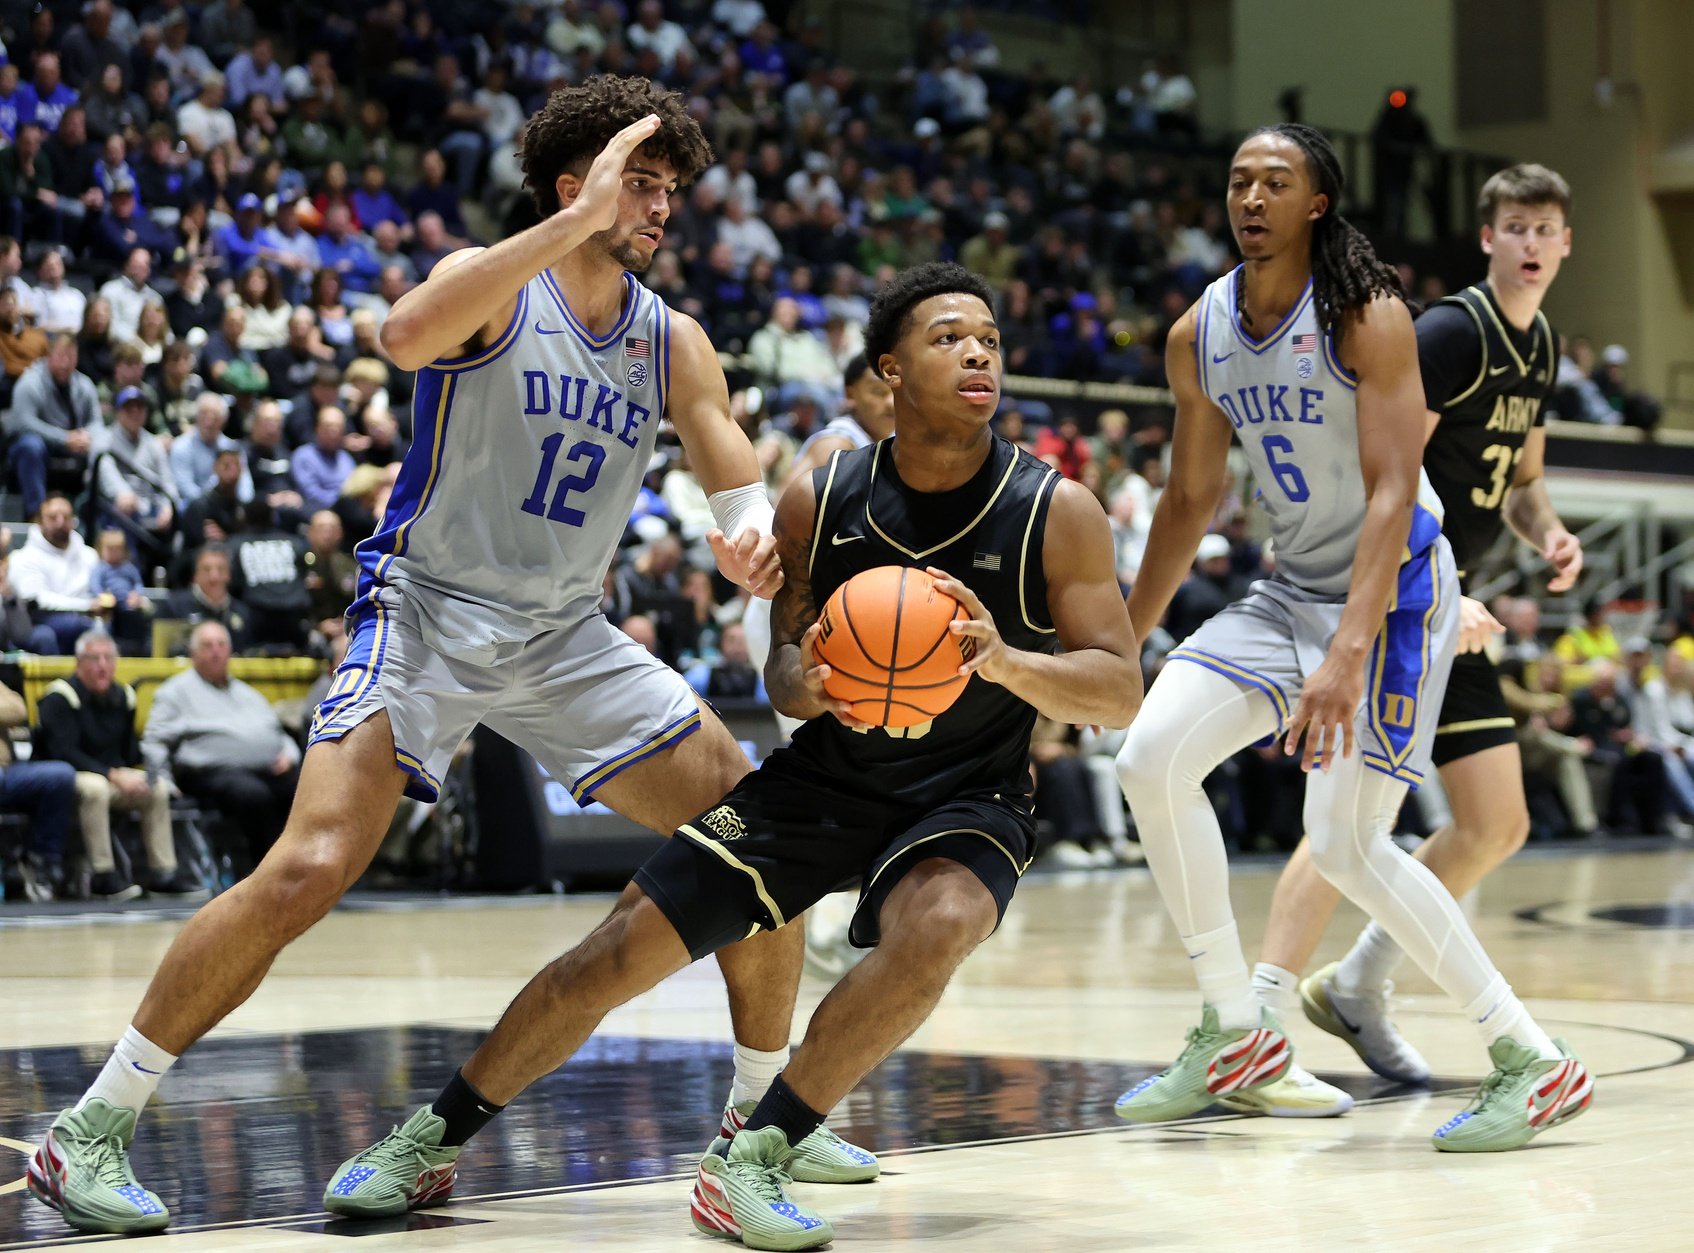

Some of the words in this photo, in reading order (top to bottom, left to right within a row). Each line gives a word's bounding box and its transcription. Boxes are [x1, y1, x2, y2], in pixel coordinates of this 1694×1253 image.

[523, 371, 651, 449] DUKE
[1218, 384, 1324, 429] DUKE
[520, 432, 607, 528] 12
[1261, 434, 1311, 503] 6
[1470, 443, 1524, 510] 3
[1382, 692, 1415, 728] D
[707, 811, 744, 839] PATRIOT
